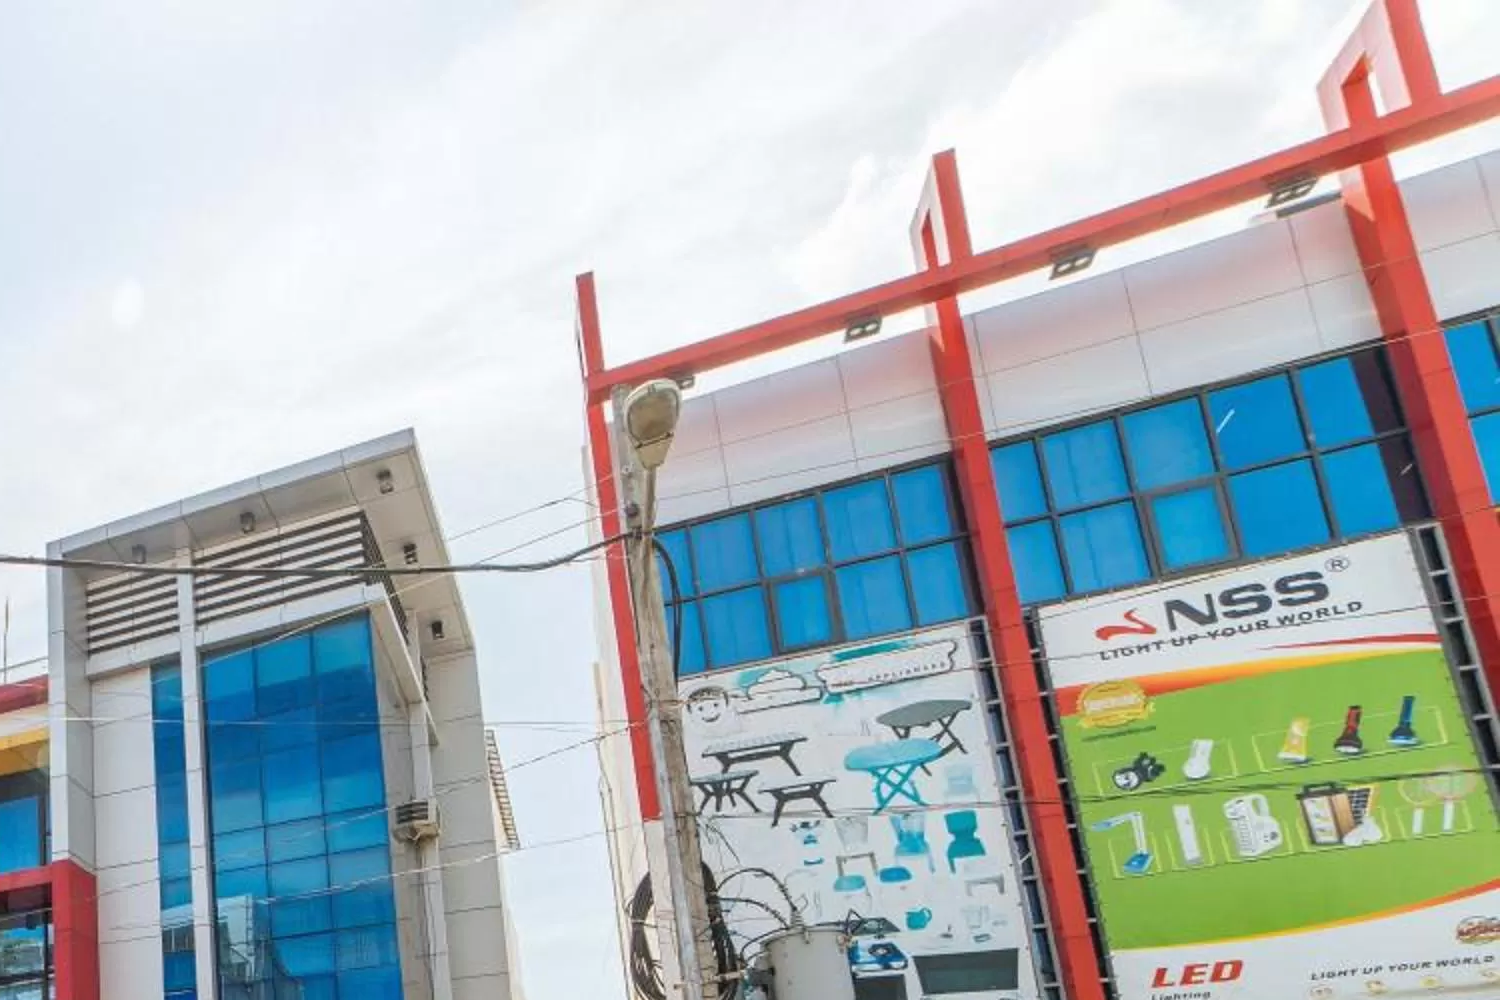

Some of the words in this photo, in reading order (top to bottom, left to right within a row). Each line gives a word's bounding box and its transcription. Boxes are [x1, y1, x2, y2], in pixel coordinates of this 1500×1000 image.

[1163, 571, 1330, 632] NSS
[1099, 639, 1165, 661] LIGHT
[1171, 633, 1200, 648] UP
[1203, 619, 1270, 639] YOUR
[1276, 601, 1363, 626] WORLD
[1151, 959, 1244, 989] LED
[1311, 967, 1359, 981] LIGHT
[1362, 965, 1383, 975] UP
[1389, 961, 1432, 974] YOUR
[1435, 955, 1495, 968] WORLD
